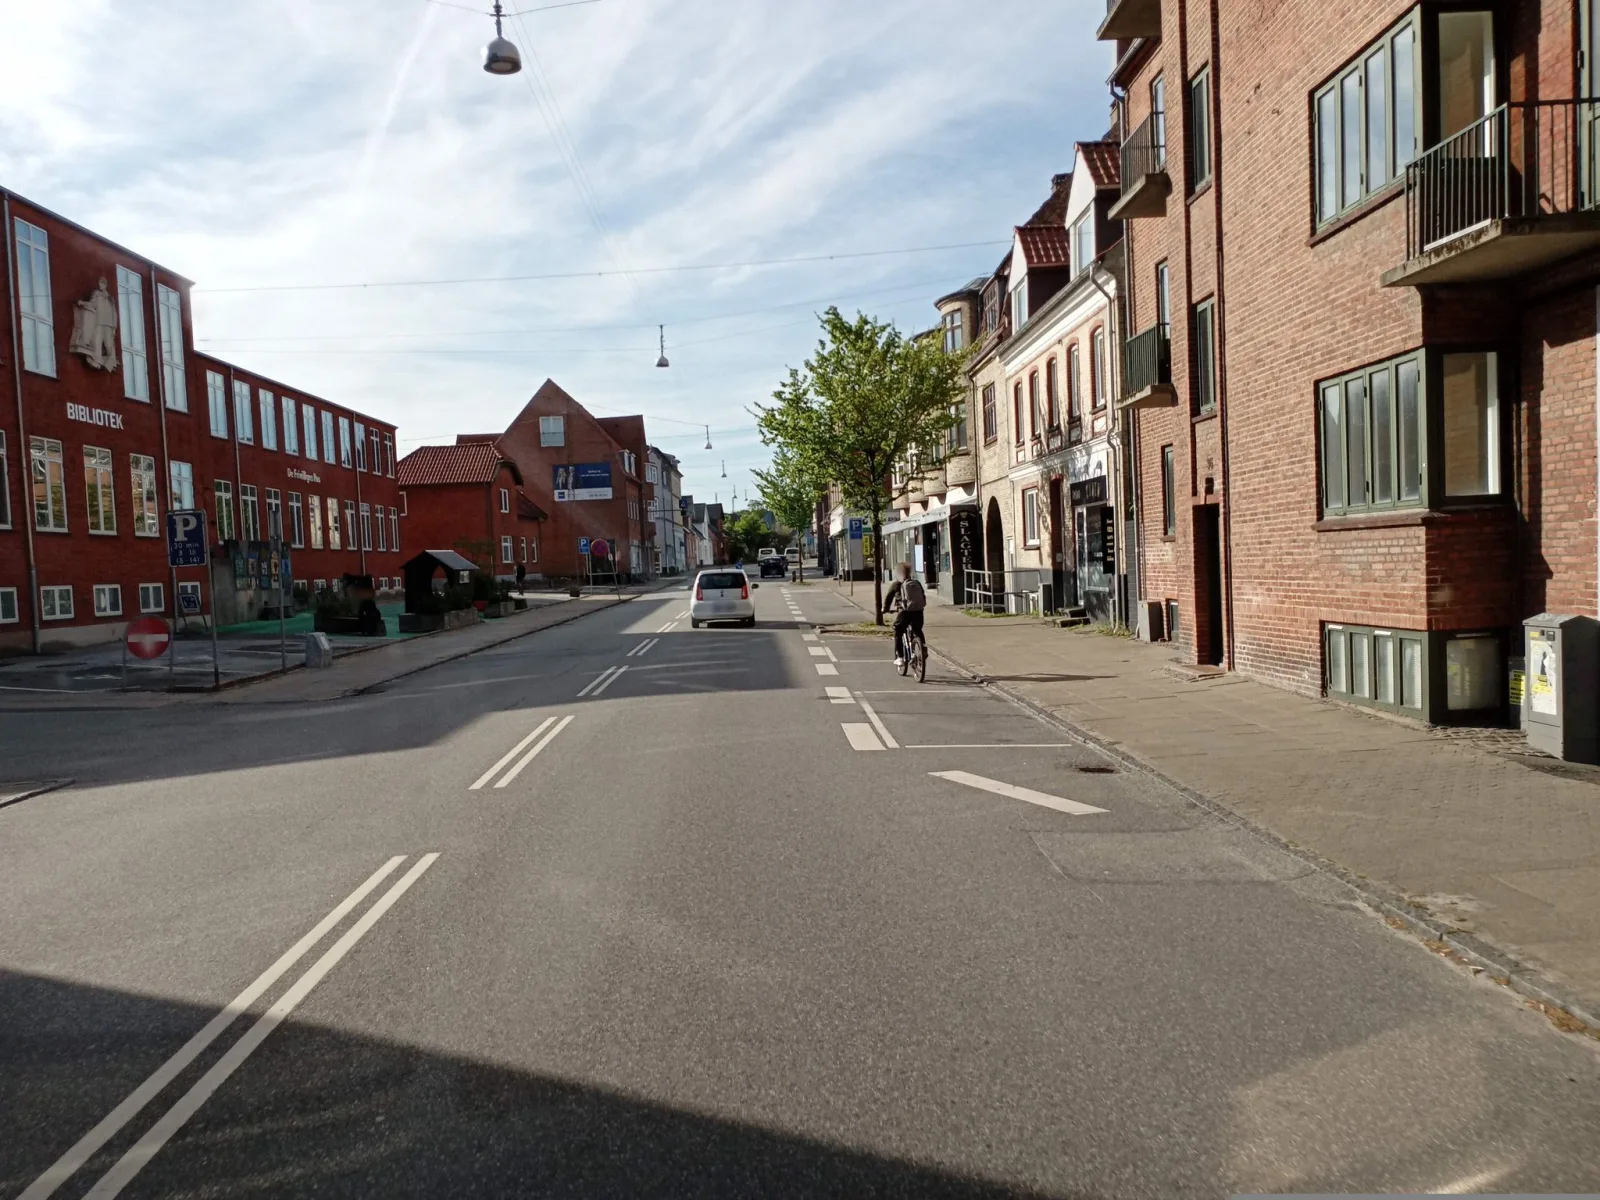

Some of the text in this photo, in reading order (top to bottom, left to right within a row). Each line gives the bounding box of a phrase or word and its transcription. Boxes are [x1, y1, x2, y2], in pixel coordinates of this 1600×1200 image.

[66, 402, 124, 430] BIBLIOTEK
[173, 515, 197, 542] P
[580, 539, 587, 547] P
[960, 520, 972, 570] SLAGTER
